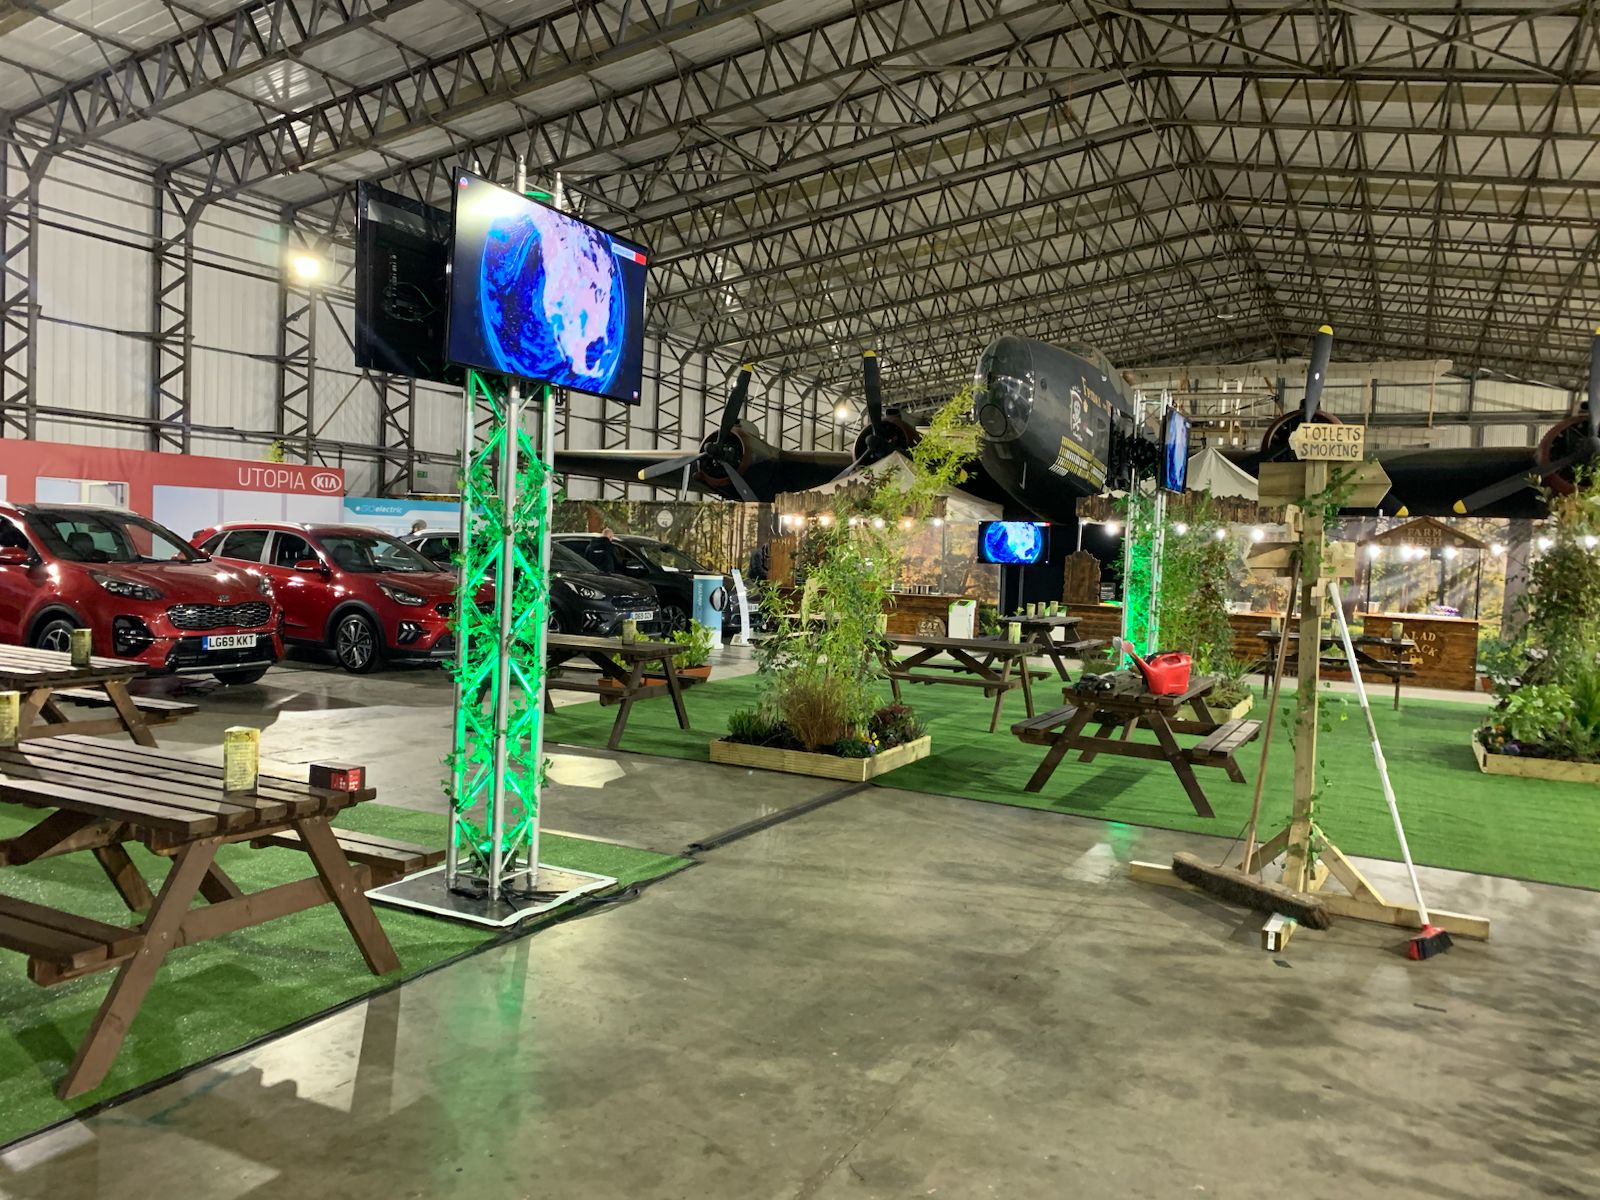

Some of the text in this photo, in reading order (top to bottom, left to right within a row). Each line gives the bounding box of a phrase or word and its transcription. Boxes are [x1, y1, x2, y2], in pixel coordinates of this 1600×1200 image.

[1302, 426, 1361, 441] TOILETS
[1301, 443, 1359, 457] SMOKING
[238, 467, 338, 490] UTOPIA KIA
[1407, 528, 1442, 537] FARM
[209, 635, 254, 648] LG69 KKT
[1403, 631, 1437, 642] ALAD
